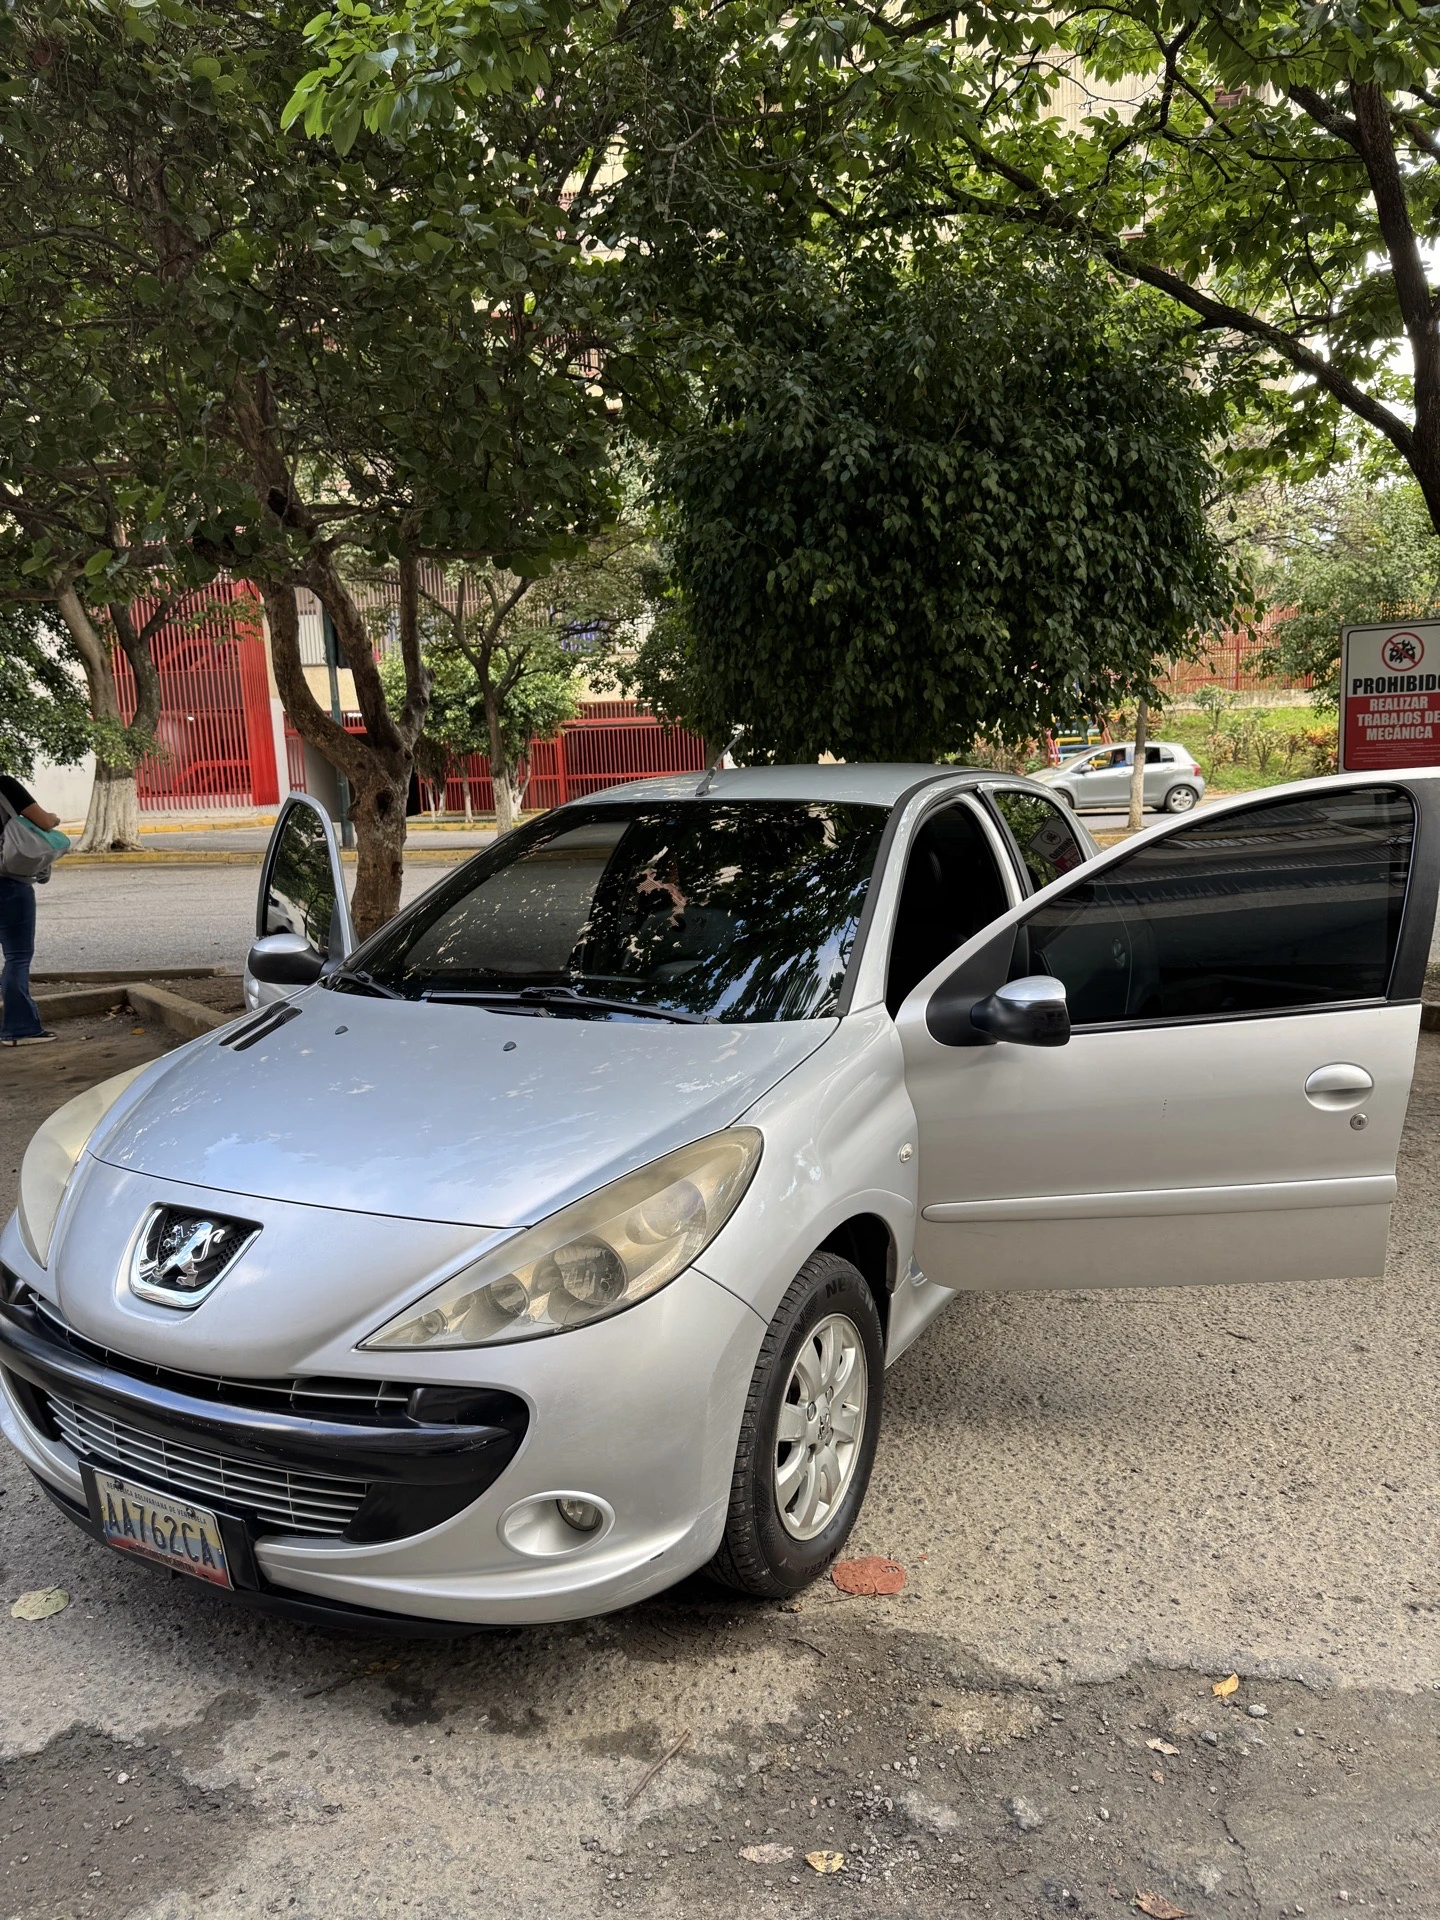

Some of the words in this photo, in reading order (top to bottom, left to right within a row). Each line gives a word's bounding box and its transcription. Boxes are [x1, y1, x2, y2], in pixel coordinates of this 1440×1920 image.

[1352, 673, 1440, 695] PROHIBID
[1369, 696, 1428, 711] REALIZAR
[1357, 711, 1422, 727] TRABAJOS
[1424, 710, 1440, 724] DE
[1366, 725, 1433, 741] MECÁNICA
[825, 1277, 874, 1312] NEEN
[134, 1492, 168, 1511] BOLIVARIANA
[168, 1505, 176, 1514] DE
[177, 1508, 208, 1525] VENEUELA
[106, 1491, 217, 1570] AA762CA
